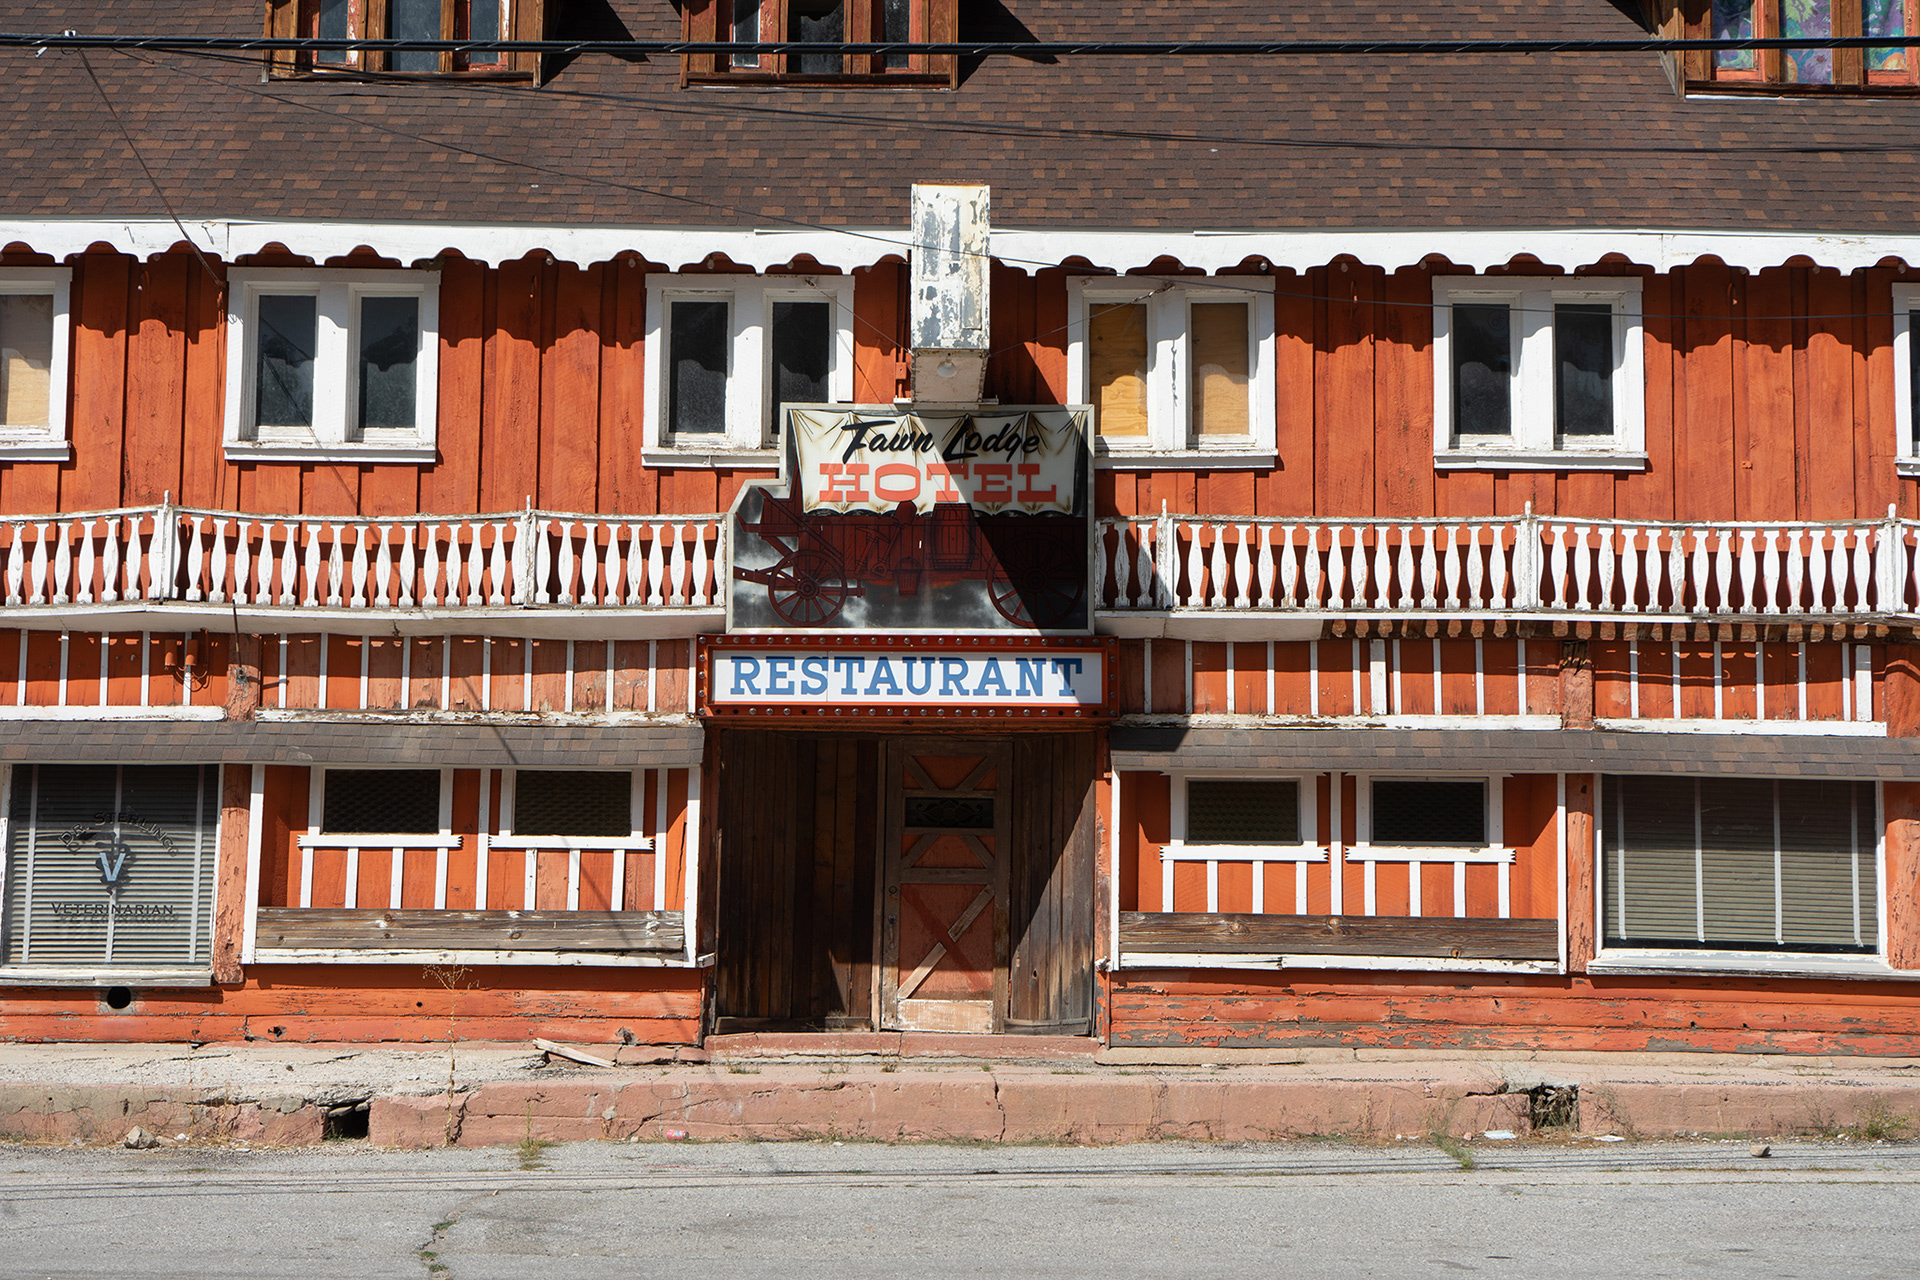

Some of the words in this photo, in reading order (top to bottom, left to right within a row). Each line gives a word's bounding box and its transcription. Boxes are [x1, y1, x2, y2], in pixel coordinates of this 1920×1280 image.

[841, 420, 934, 464] Fawn
[942, 418, 1040, 462] Lodge
[819, 463, 1056, 502] HOTEL
[730, 656, 1082, 696] RESTAURANT
[59, 823, 90, 846] DR.
[99, 852, 126, 881] V
[51, 902, 174, 915] VETERINARIAN
